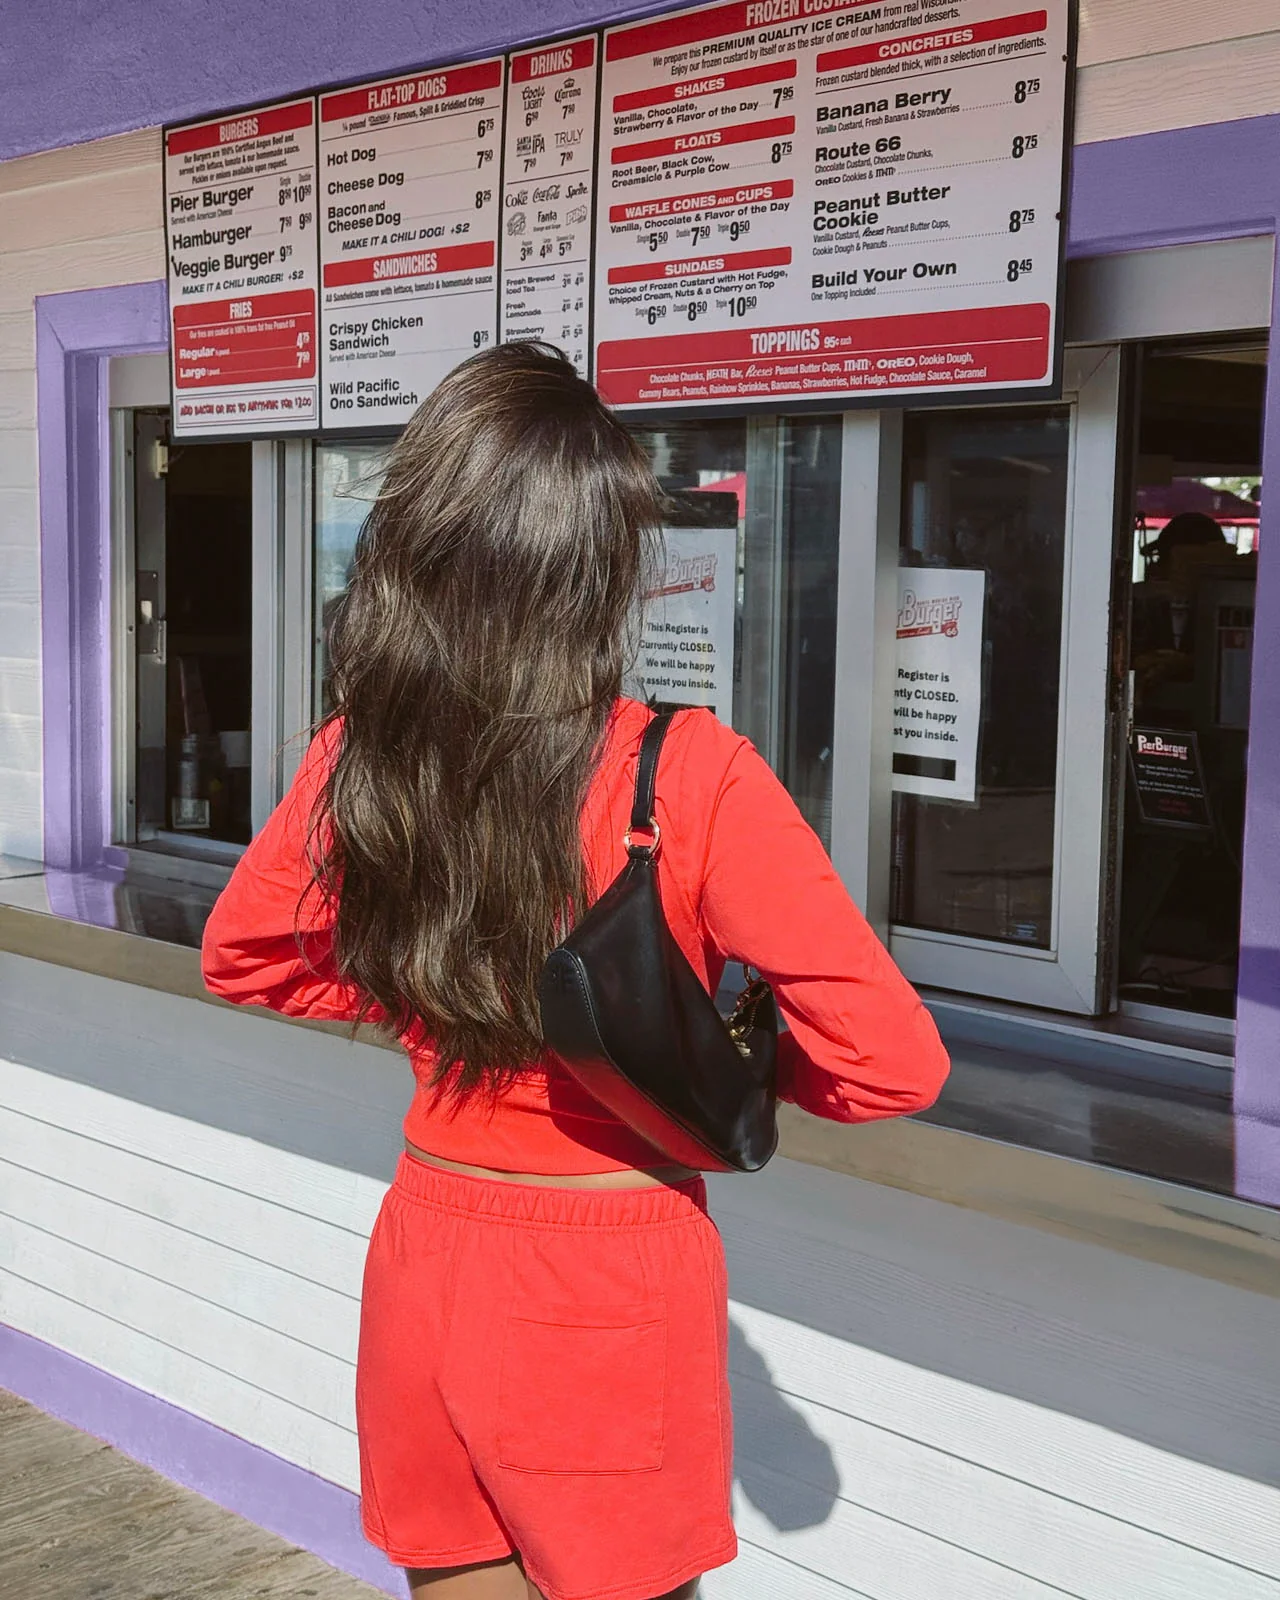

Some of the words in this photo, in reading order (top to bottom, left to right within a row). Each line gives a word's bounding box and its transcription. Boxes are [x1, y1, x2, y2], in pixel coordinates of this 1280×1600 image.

[746, 0, 799, 26] FROZEN
[702, 35, 755, 56] PREMIUM
[758, 24, 808, 42] QUALITY
[812, 19, 832, 32] ICE
[836, 9, 880, 26] CREAM
[884, 6, 901, 18] from
[903, 3, 919, 13] real
[811, 35, 824, 46] star
[827, 32, 834, 43] of
[836, 31, 849, 39] one
[851, 27, 858, 38] of
[860, 26, 872, 35] our
[875, 16, 923, 34] handcrafted
[925, 8, 960, 23] desserts.
[878, 29, 973, 58] CONCRETES
[530, 48, 573, 76] DRINKS
[815, 76, 839, 88] Frozen
[841, 69, 868, 82] custard
[870, 64, 900, 79] blended
[902, 60, 922, 74] thick,
[925, 56, 941, 68] with
[943, 55, 949, 64] a
[950, 48, 986, 63] selection
[988, 44, 996, 56] of
[998, 38, 1046, 55] ingredients.
[368, 82, 415, 109] FLAT-TOP
[418, 76, 446, 99] DOGS
[674, 78, 725, 98] SHAKES
[420, 105, 433, 116] Split
[435, 104, 439, 113] &
[441, 98, 467, 112] Griddled
[468, 96, 484, 107] Crisp
[524, 98, 542, 110] LIGHT
[614, 110, 645, 126] Vanilla,
[648, 103, 698, 118] Chocolate,
[817, 98, 889, 122] Banana
[895, 87, 951, 110] Berry
[865, 116, 883, 127] Fresh
[884, 112, 909, 125] Banana
[910, 111, 916, 119] &
[917, 103, 960, 119] Strawberries
[613, 117, 664, 135] Strawberry
[668, 116, 673, 125] &
[677, 112, 705, 123] Flavor
[709, 107, 718, 116] of
[721, 104, 737, 115] the
[739, 101, 759, 113] Day
[220, 118, 258, 141] BURGERS
[533, 137, 545, 154] IPA
[554, 128, 583, 144] TRULY
[675, 132, 722, 151] FLOATS
[815, 144, 870, 162] Route
[875, 136, 901, 152] 66
[327, 152, 348, 166] Hot
[352, 147, 376, 161] Dog
[612, 167, 634, 179] Root
[635, 161, 659, 175] Beer,
[662, 156, 689, 171] Black
[691, 154, 715, 166] Cow,
[328, 177, 374, 195] Cheese
[378, 172, 404, 185] Dog
[612, 173, 662, 188] Creamsicle
[675, 167, 705, 179] Purple
[708, 164, 730, 173] Cow
[171, 195, 199, 213] Pier
[203, 186, 254, 207] Burger
[328, 203, 367, 219] Bacon
[368, 201, 385, 213] and
[625, 202, 670, 219] WAFFLE
[673, 195, 716, 211] CONES
[717, 196, 734, 205] AND
[736, 187, 773, 201] CUPS
[814, 193, 880, 215] Peanut
[887, 185, 951, 205] Butter
[328, 216, 373, 233] Cheese
[376, 212, 401, 226] Dog
[538, 210, 557, 223] Fanta
[611, 222, 642, 234] Vanilla,
[645, 215, 692, 229] Chocolate
[695, 213, 701, 221] &
[704, 210, 735, 220] Flavor
[738, 206, 748, 215] of
[751, 205, 767, 214] the
[770, 202, 790, 211] Day
[813, 210, 878, 231] Cookie
[173, 225, 252, 250] Hamburger
[172, 256, 220, 278] Veggie
[224, 249, 274, 274] Burger
[373, 252, 437, 279] SANDWICHES
[665, 258, 724, 276] SUNDAES
[609, 286, 637, 295] Choice
[639, 283, 648, 292] of
[650, 281, 678, 290] Frozen
[680, 274, 715, 288] Custard
[717, 273, 736, 283] with
[738, 271, 755, 281] Hot
[757, 268, 788, 280] Fudge,
[811, 270, 858, 289] Build
[863, 267, 907, 284] Your
[913, 261, 957, 278] Own
[182, 283, 204, 295] MAKE
[206, 282, 214, 292] IT
[215, 281, 221, 290] A
[223, 278, 243, 289] CHILI
[811, 291, 823, 301] One
[825, 289, 848, 301] Topping
[849, 287, 876, 298] Included
[230, 301, 252, 319] FRIES
[329, 323, 368, 335] Crispy
[372, 316, 423, 331] Chicken
[329, 334, 389, 351] Sandwich
[751, 328, 820, 354] TOPPINGS
[180, 347, 215, 360] Regular
[180, 367, 206, 379] Large
[330, 380, 353, 395] Wild
[357, 379, 399, 393] Pacific
[330, 398, 353, 409] Ono
[357, 392, 418, 408] Sandwich
[648, 622, 663, 632] This
[665, 623, 699, 634] Register
[701, 625, 708, 634] is
[680, 643, 716, 653] CLOSED.
[646, 658, 658, 667] We
[660, 659, 675, 669] will
[677, 660, 687, 670] be
[689, 661, 715, 673] happy
[898, 669, 939, 683] Register
[941, 672, 950, 683] is
[646, 676, 670, 686] assist
[672, 680, 686, 688] you
[688, 680, 716, 690] inside.
[915, 690, 959, 703] CLOSED.
[911, 709, 923, 719] be
[926, 710, 957, 724] happy
[905, 728, 922, 739] you
[925, 729, 958, 742] inside.
